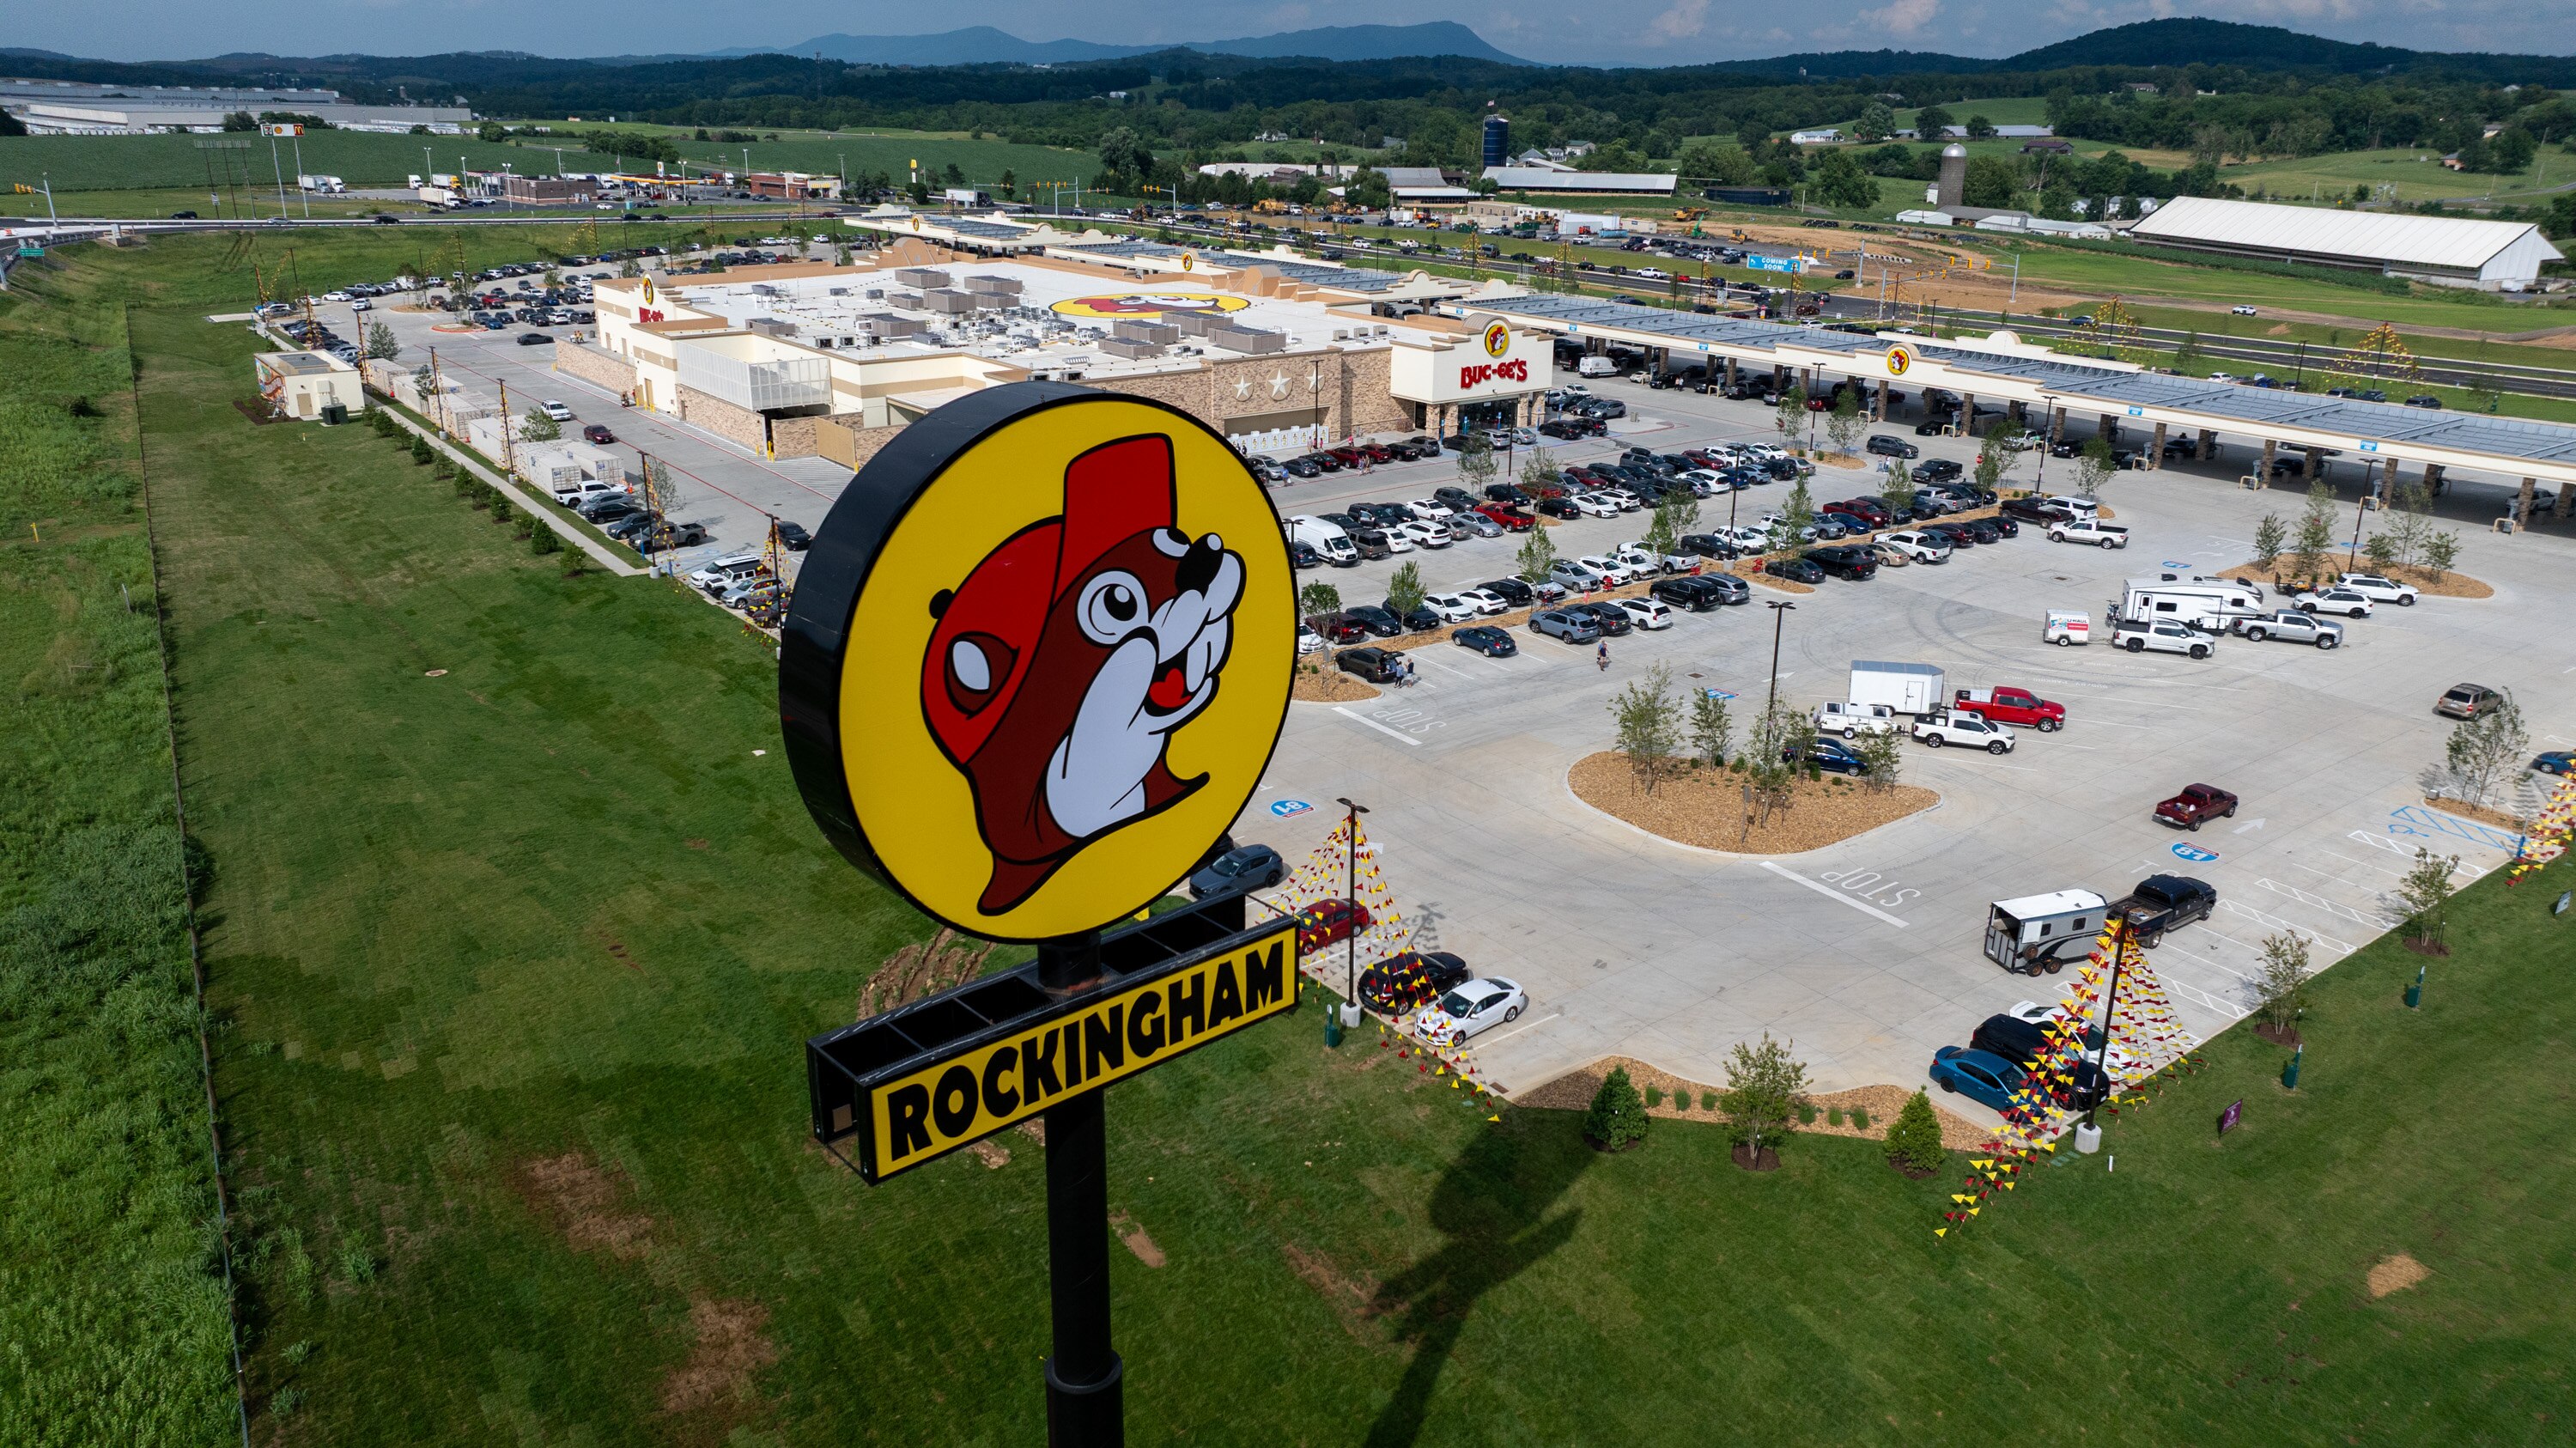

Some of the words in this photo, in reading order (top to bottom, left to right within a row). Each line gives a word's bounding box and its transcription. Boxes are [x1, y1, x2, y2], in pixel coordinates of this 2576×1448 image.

[1761, 257, 1788, 265] COMING
[1373, 708, 1447, 733] STOP
[1274, 801, 1303, 813] 81
[2174, 846, 2208, 861] 81
[1820, 867, 1922, 907] STOP
[887, 940, 1285, 1162] ROCKINGHAM
